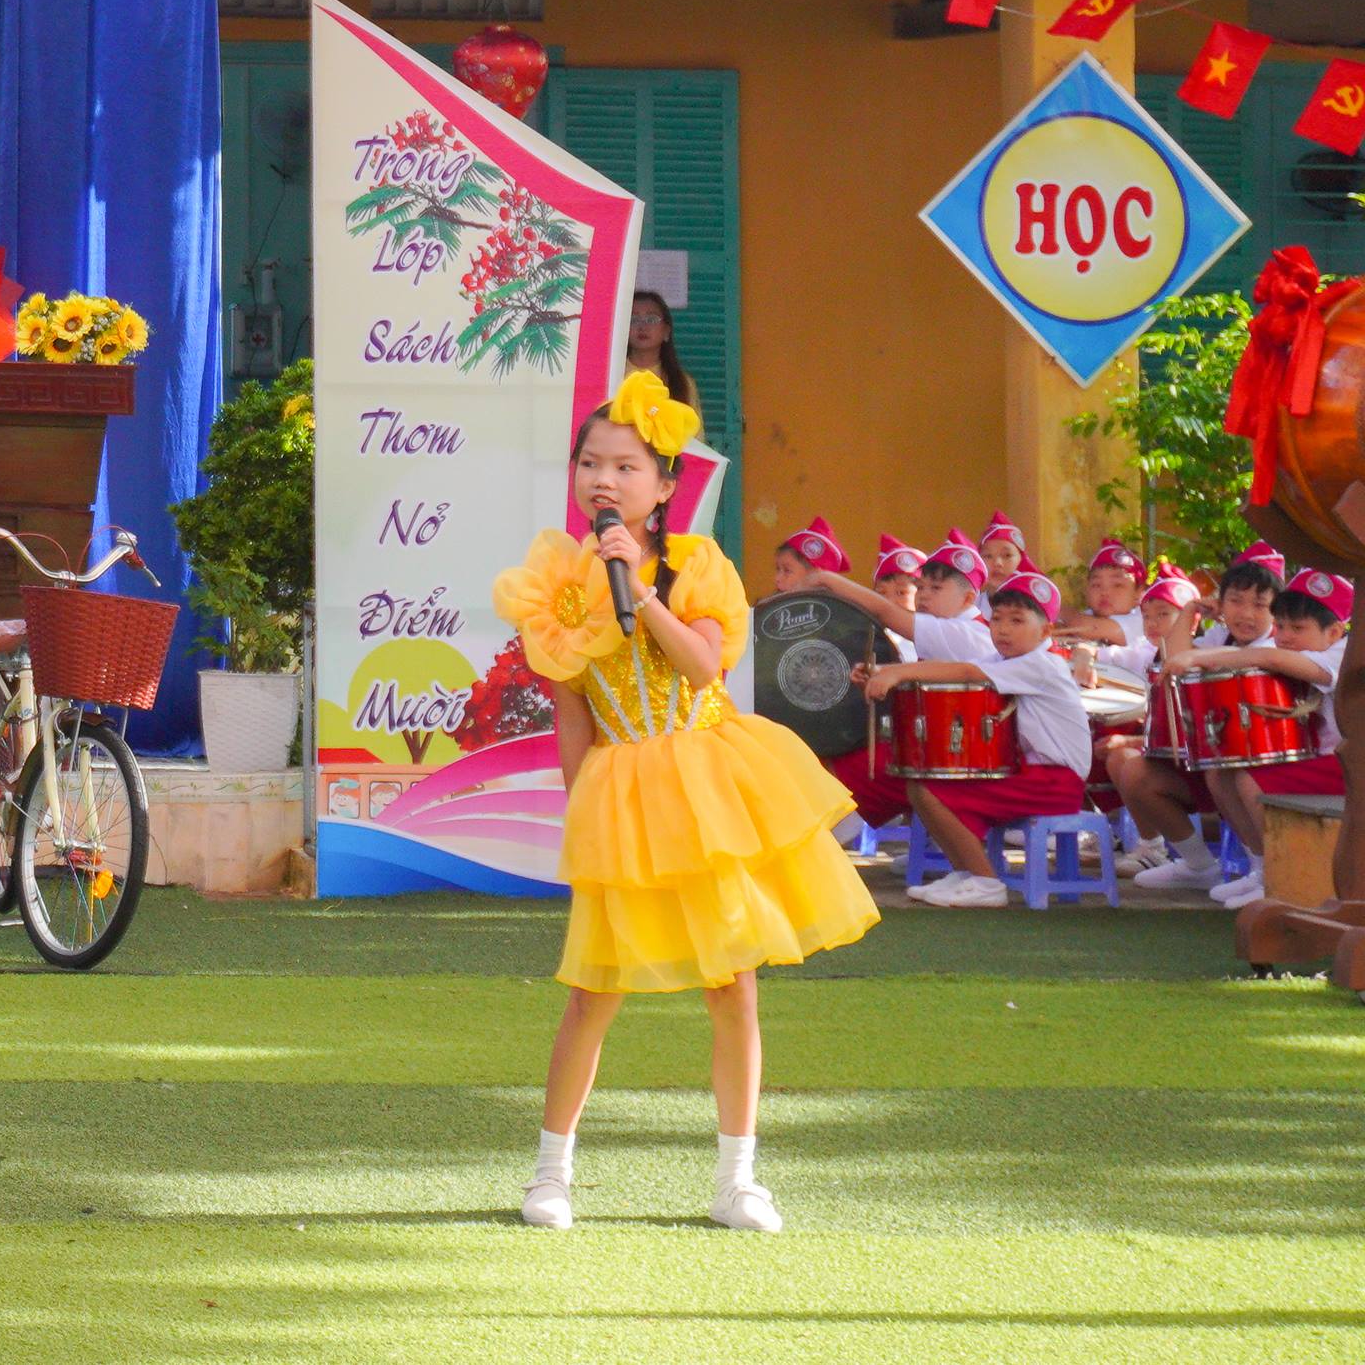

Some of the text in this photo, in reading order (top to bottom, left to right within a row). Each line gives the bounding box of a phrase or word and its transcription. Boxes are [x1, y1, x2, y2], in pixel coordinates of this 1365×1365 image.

[353, 135, 469, 195] Trong
[1015, 183, 1153, 274] HỌC
[372, 227, 444, 286] Lớp
[364, 319, 456, 364] Sách
[359, 408, 466, 456] Thơm
[379, 500, 450, 546] Nở
[359, 587, 466, 641] Điểm
[356, 678, 471, 732] Mười
